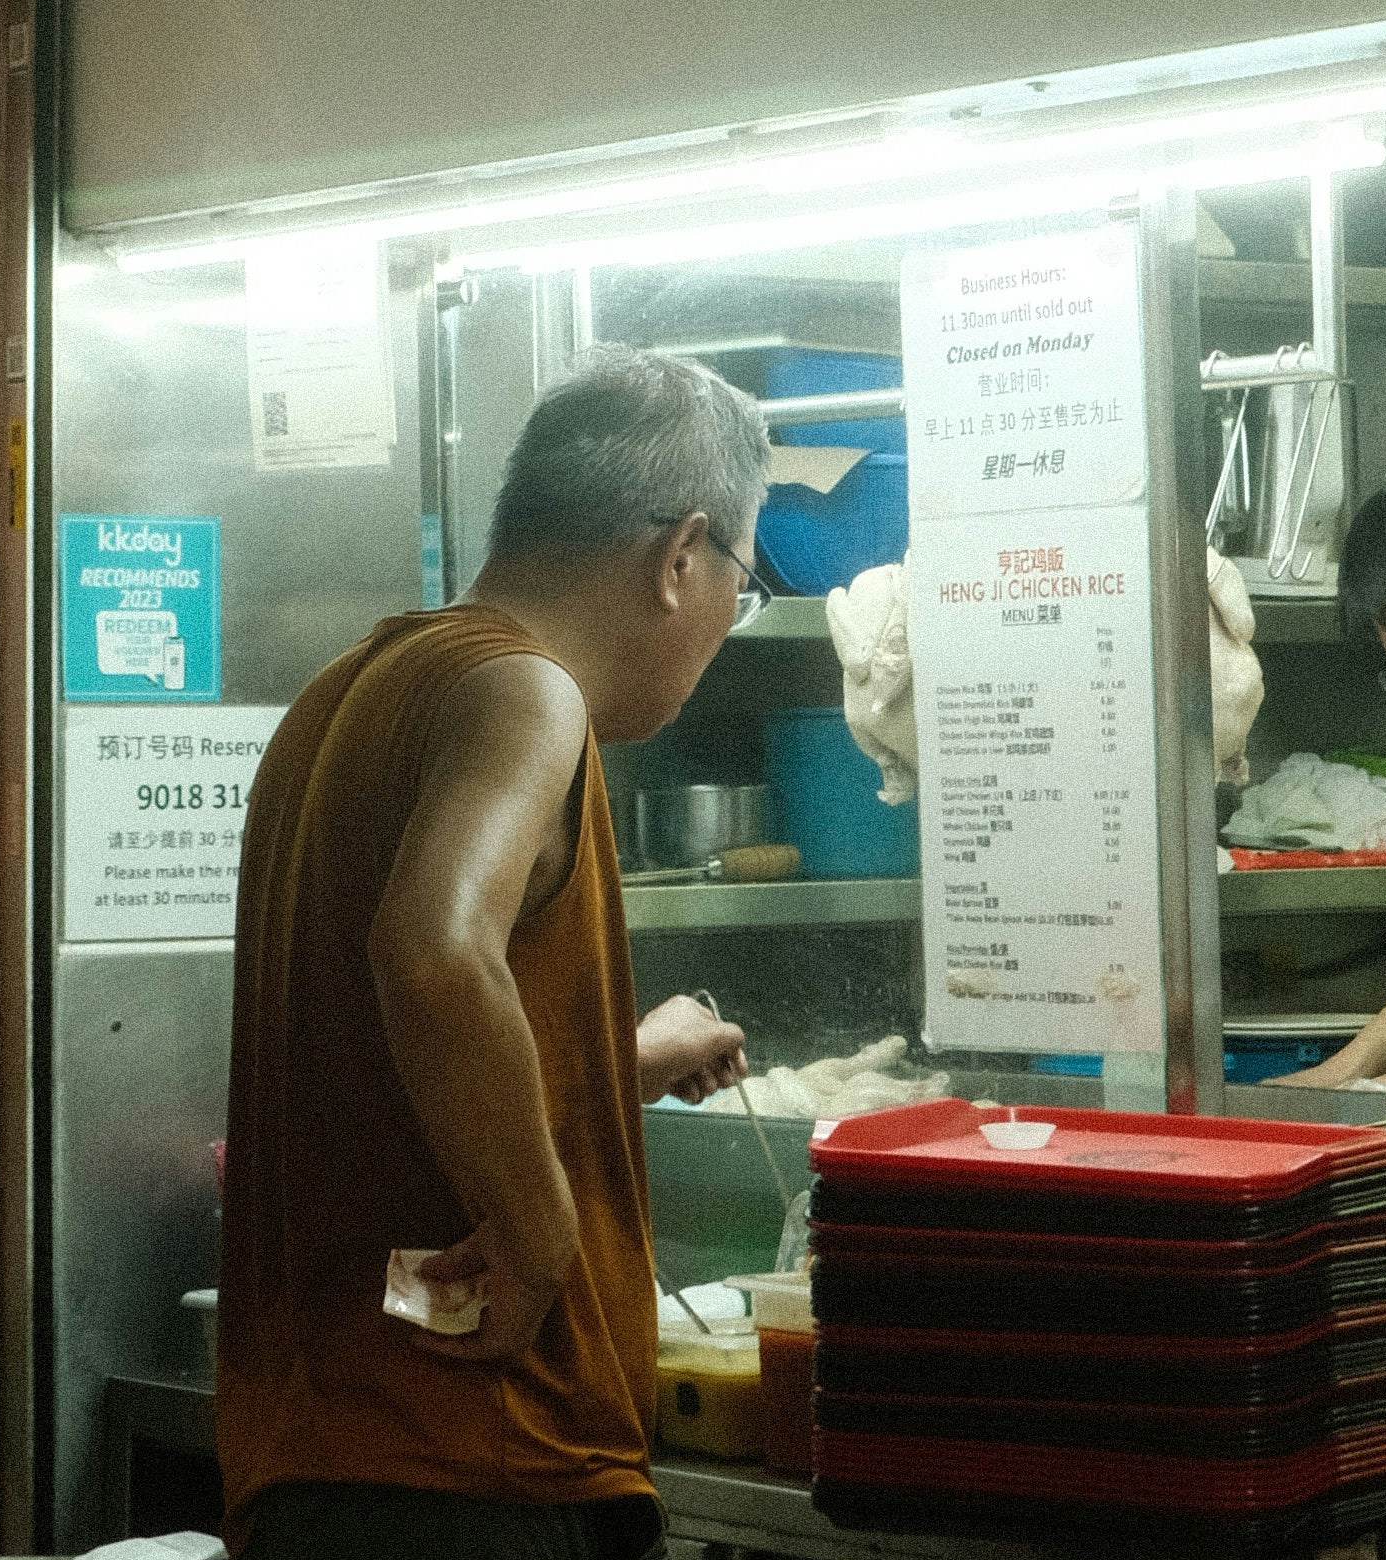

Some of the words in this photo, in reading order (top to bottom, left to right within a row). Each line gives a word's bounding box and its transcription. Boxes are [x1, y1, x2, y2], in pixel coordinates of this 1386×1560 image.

[960, 273, 1017, 297] Business
[1020, 266, 1066, 288] Hours:
[1001, 302, 1032, 326] until
[1035, 299, 1065, 321] sold
[1067, 295, 1093, 317] out
[946, 340, 999, 366] Closed
[1002, 341, 1023, 358] on
[1026, 329, 1094, 356] Monday
[980, 448, 1067, 481] 星期一休息
[97, 523, 182, 566] kkday
[80, 567, 201, 589] RECOMMENDS
[939, 580, 985, 604] HENG
[990, 579, 1003, 602] JI
[1007, 576, 1083, 601] CHICKEN
[1088, 572, 1125, 596] RICE
[119, 589, 163, 609] 2023
[104, 618, 172, 635] REDEEM
[1001, 608, 1034, 624] MENU
[98, 735, 194, 761] 预订号码
[136, 783, 203, 811] 9018
[104, 864, 151, 881] Please
[155, 864, 195, 880] make
[198, 863, 222, 880] the
[94, 892, 109, 907] at
[113, 890, 149, 906] least
[153, 891, 171, 906] 30
[174, 890, 231, 906] minutes
